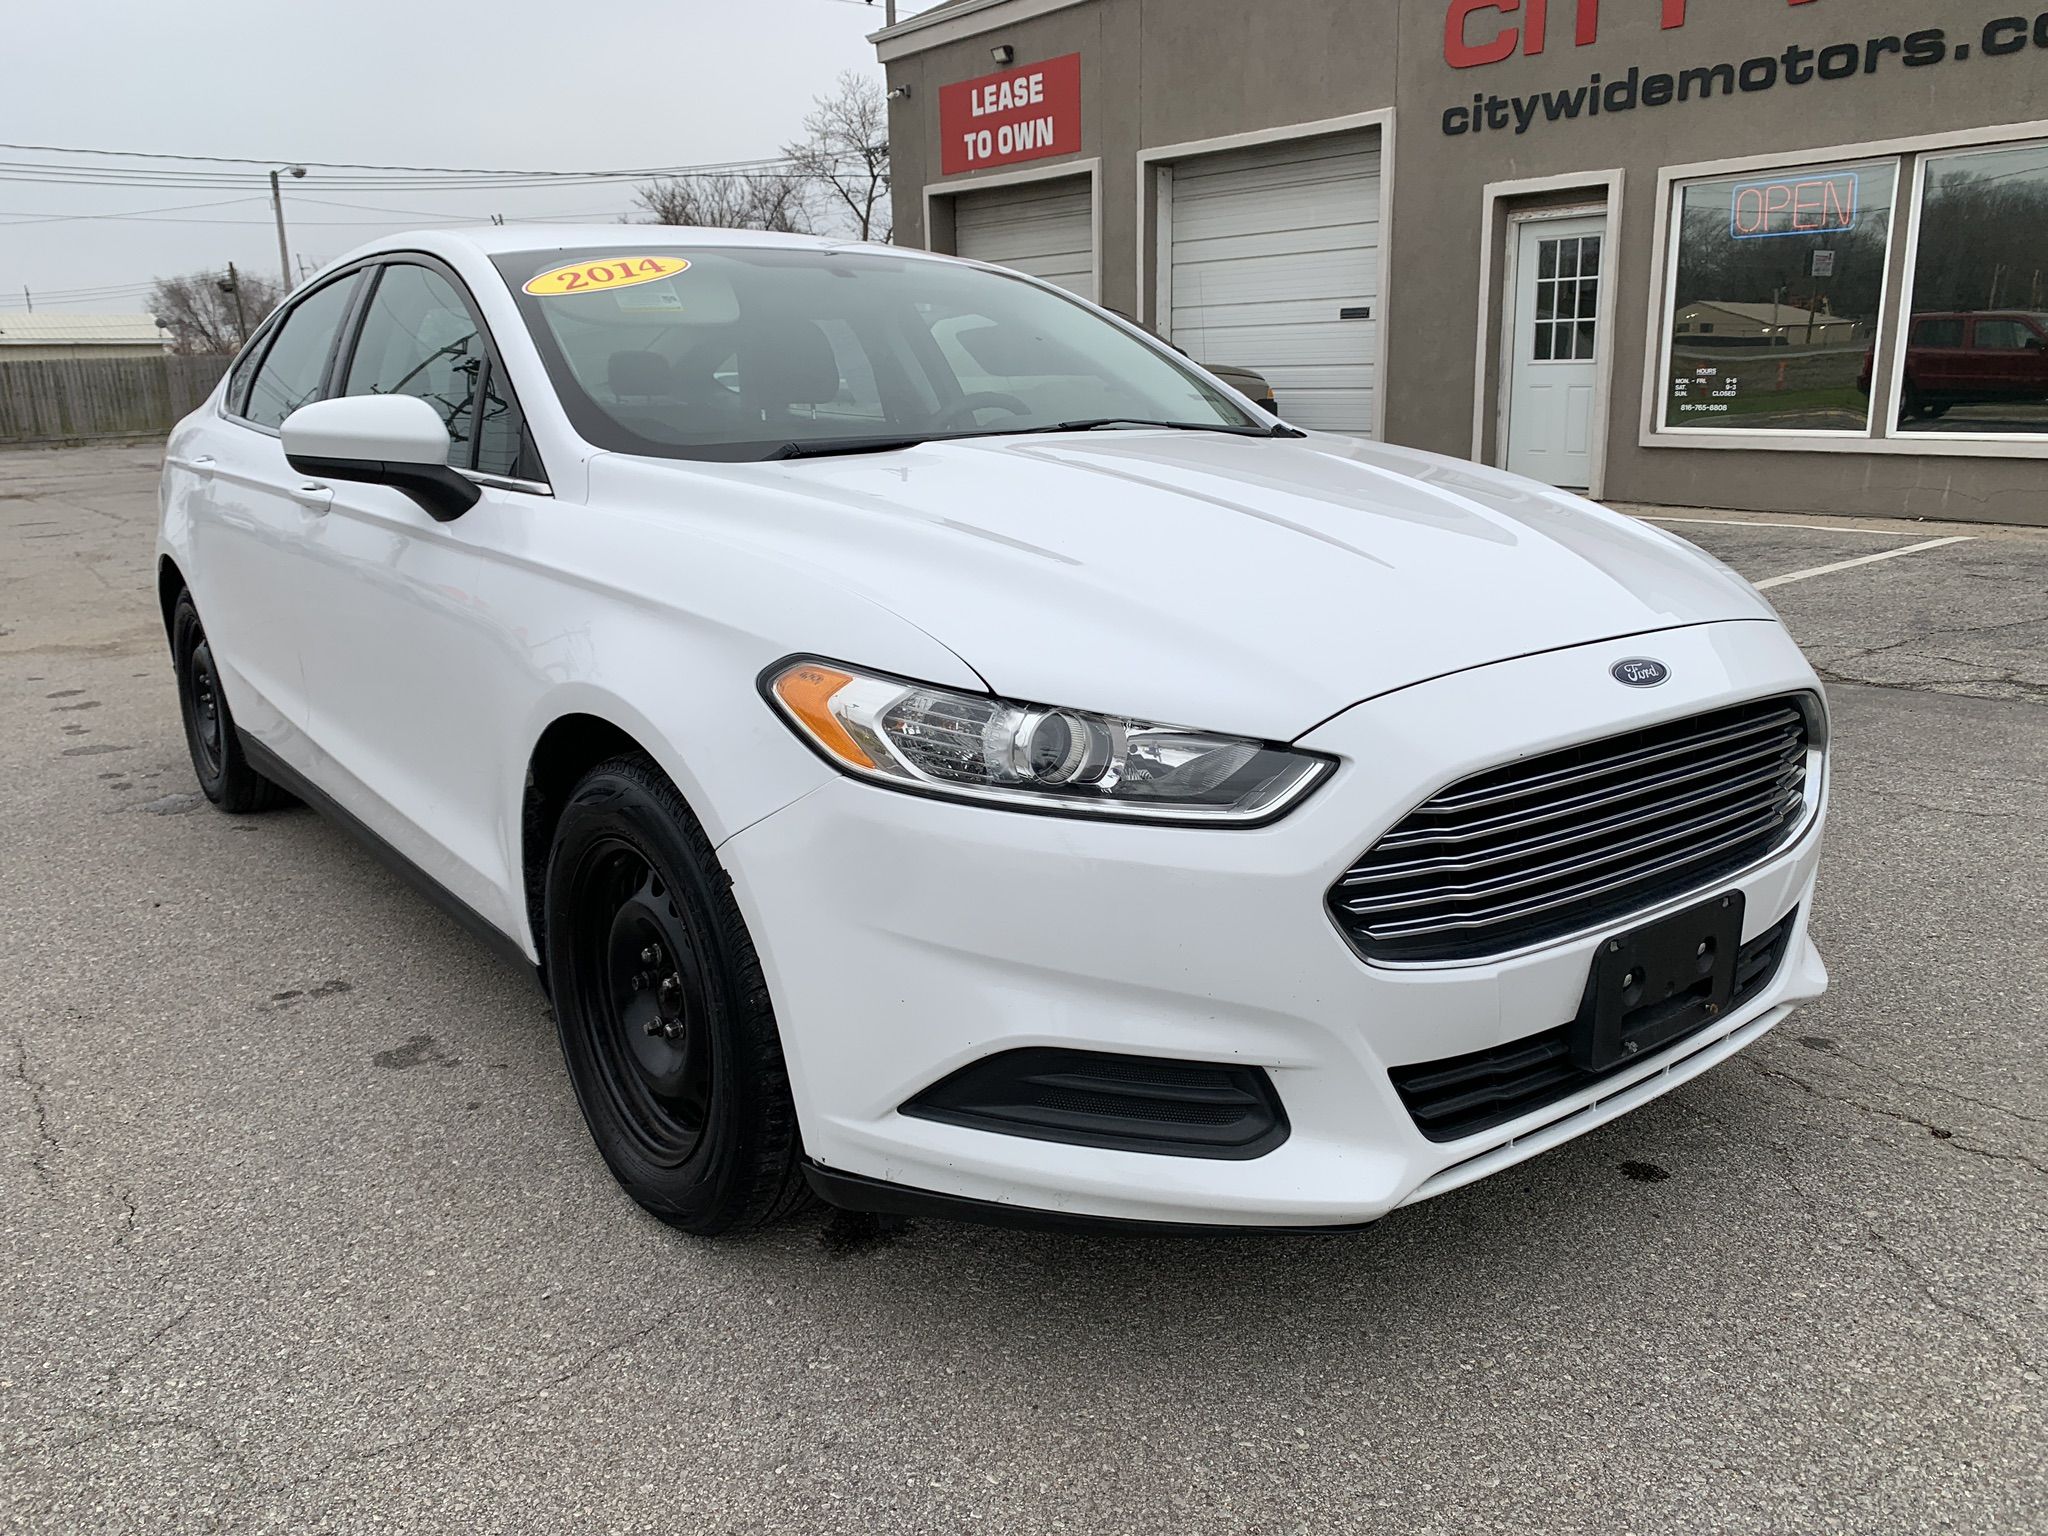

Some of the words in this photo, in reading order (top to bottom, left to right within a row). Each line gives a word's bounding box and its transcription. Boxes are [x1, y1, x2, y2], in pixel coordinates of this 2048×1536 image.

[971, 72, 1044, 117] LEASE
[963, 129, 992, 160] TO
[997, 115, 1054, 155] OWN
[1736, 179, 1853, 233] OPEN
[556, 258, 667, 291] 2014
[1696, 368, 1717, 376] HOURS
[1623, 662, 1659, 682] Ford
